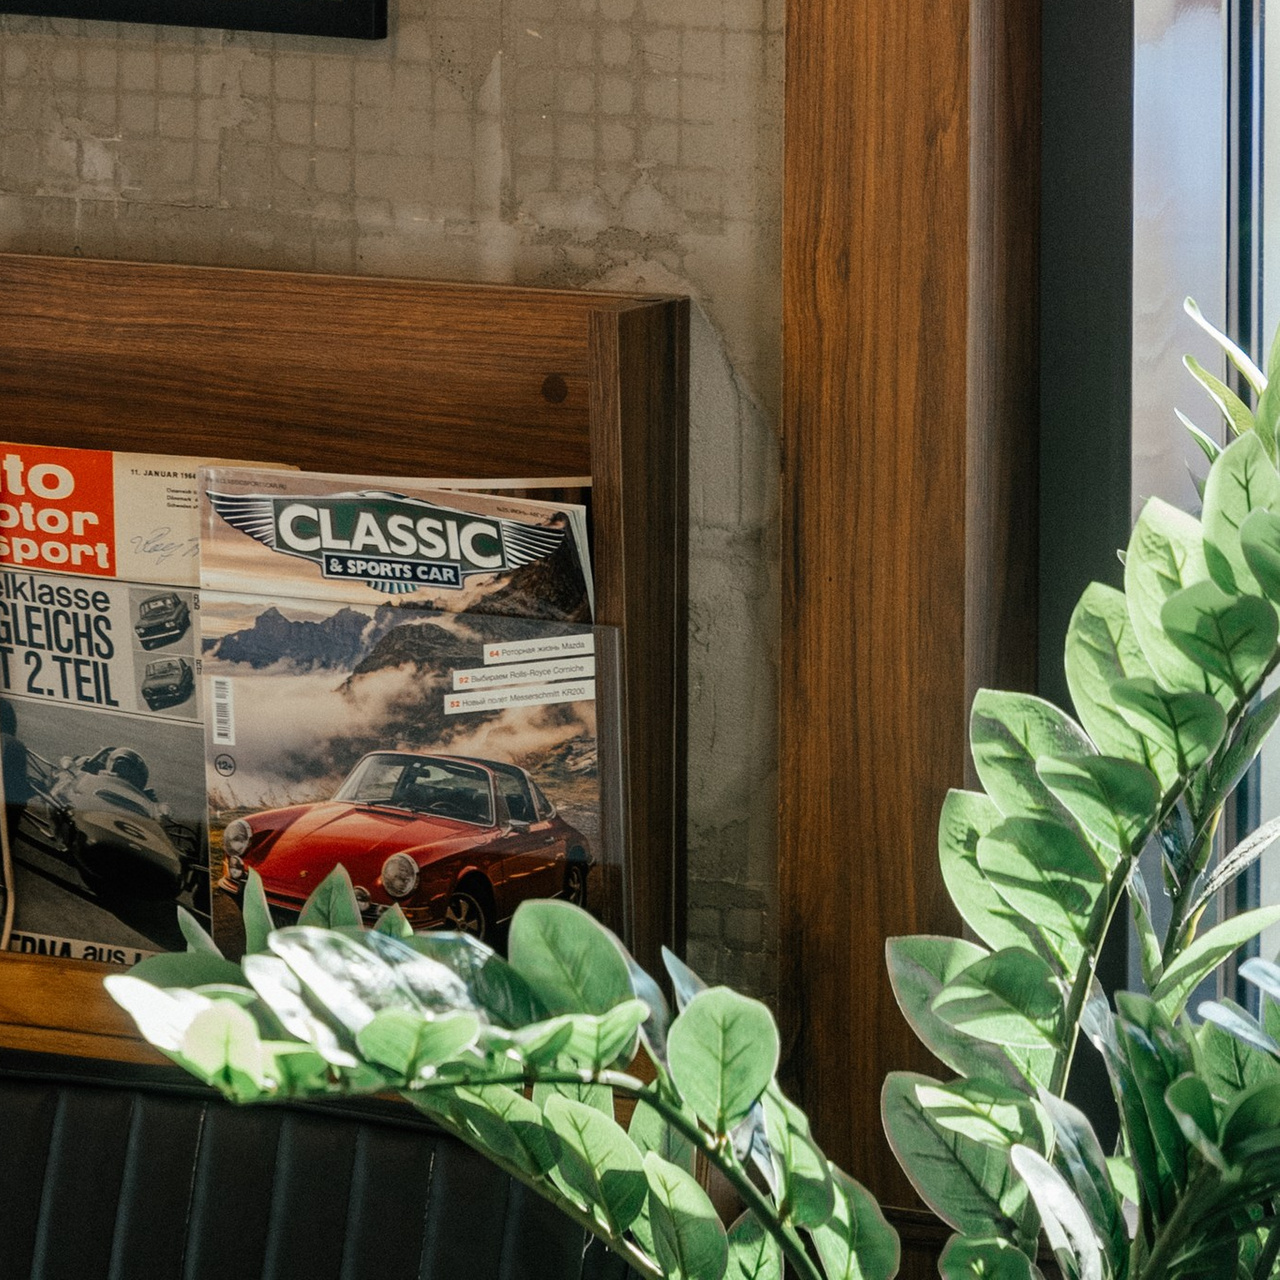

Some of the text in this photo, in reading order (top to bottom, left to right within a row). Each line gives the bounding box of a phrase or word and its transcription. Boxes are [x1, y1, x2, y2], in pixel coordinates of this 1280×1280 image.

[143, 470, 178, 478] JANUAR
[278, 503, 503, 569] CLASSIC
[329, 557, 456, 582] & SPORTS CAR
[561, 642, 585, 650] Mazda
[509, 668, 552, 680] Rolls-Royce
